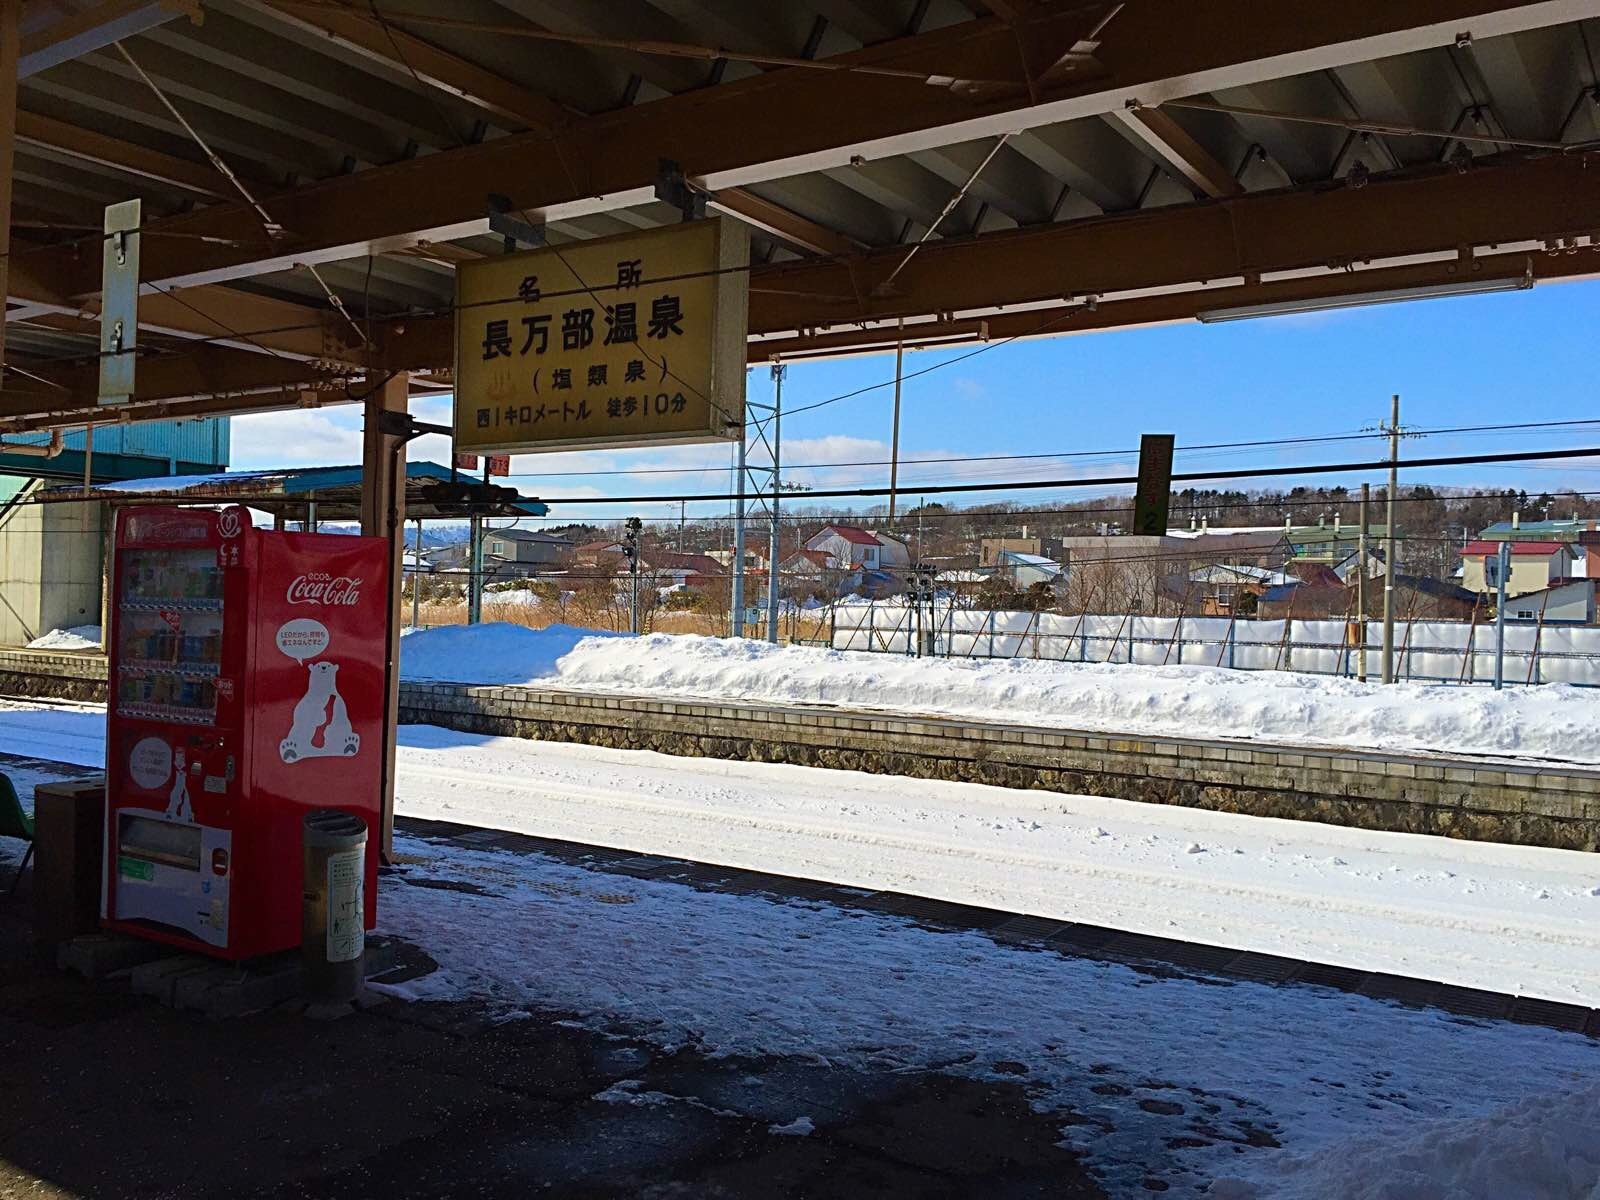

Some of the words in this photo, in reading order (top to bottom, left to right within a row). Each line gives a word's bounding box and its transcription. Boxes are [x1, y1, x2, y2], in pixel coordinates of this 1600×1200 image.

[481, 294, 684, 361] 長万部温泉
[606, 392, 688, 419] 徒歩10分
